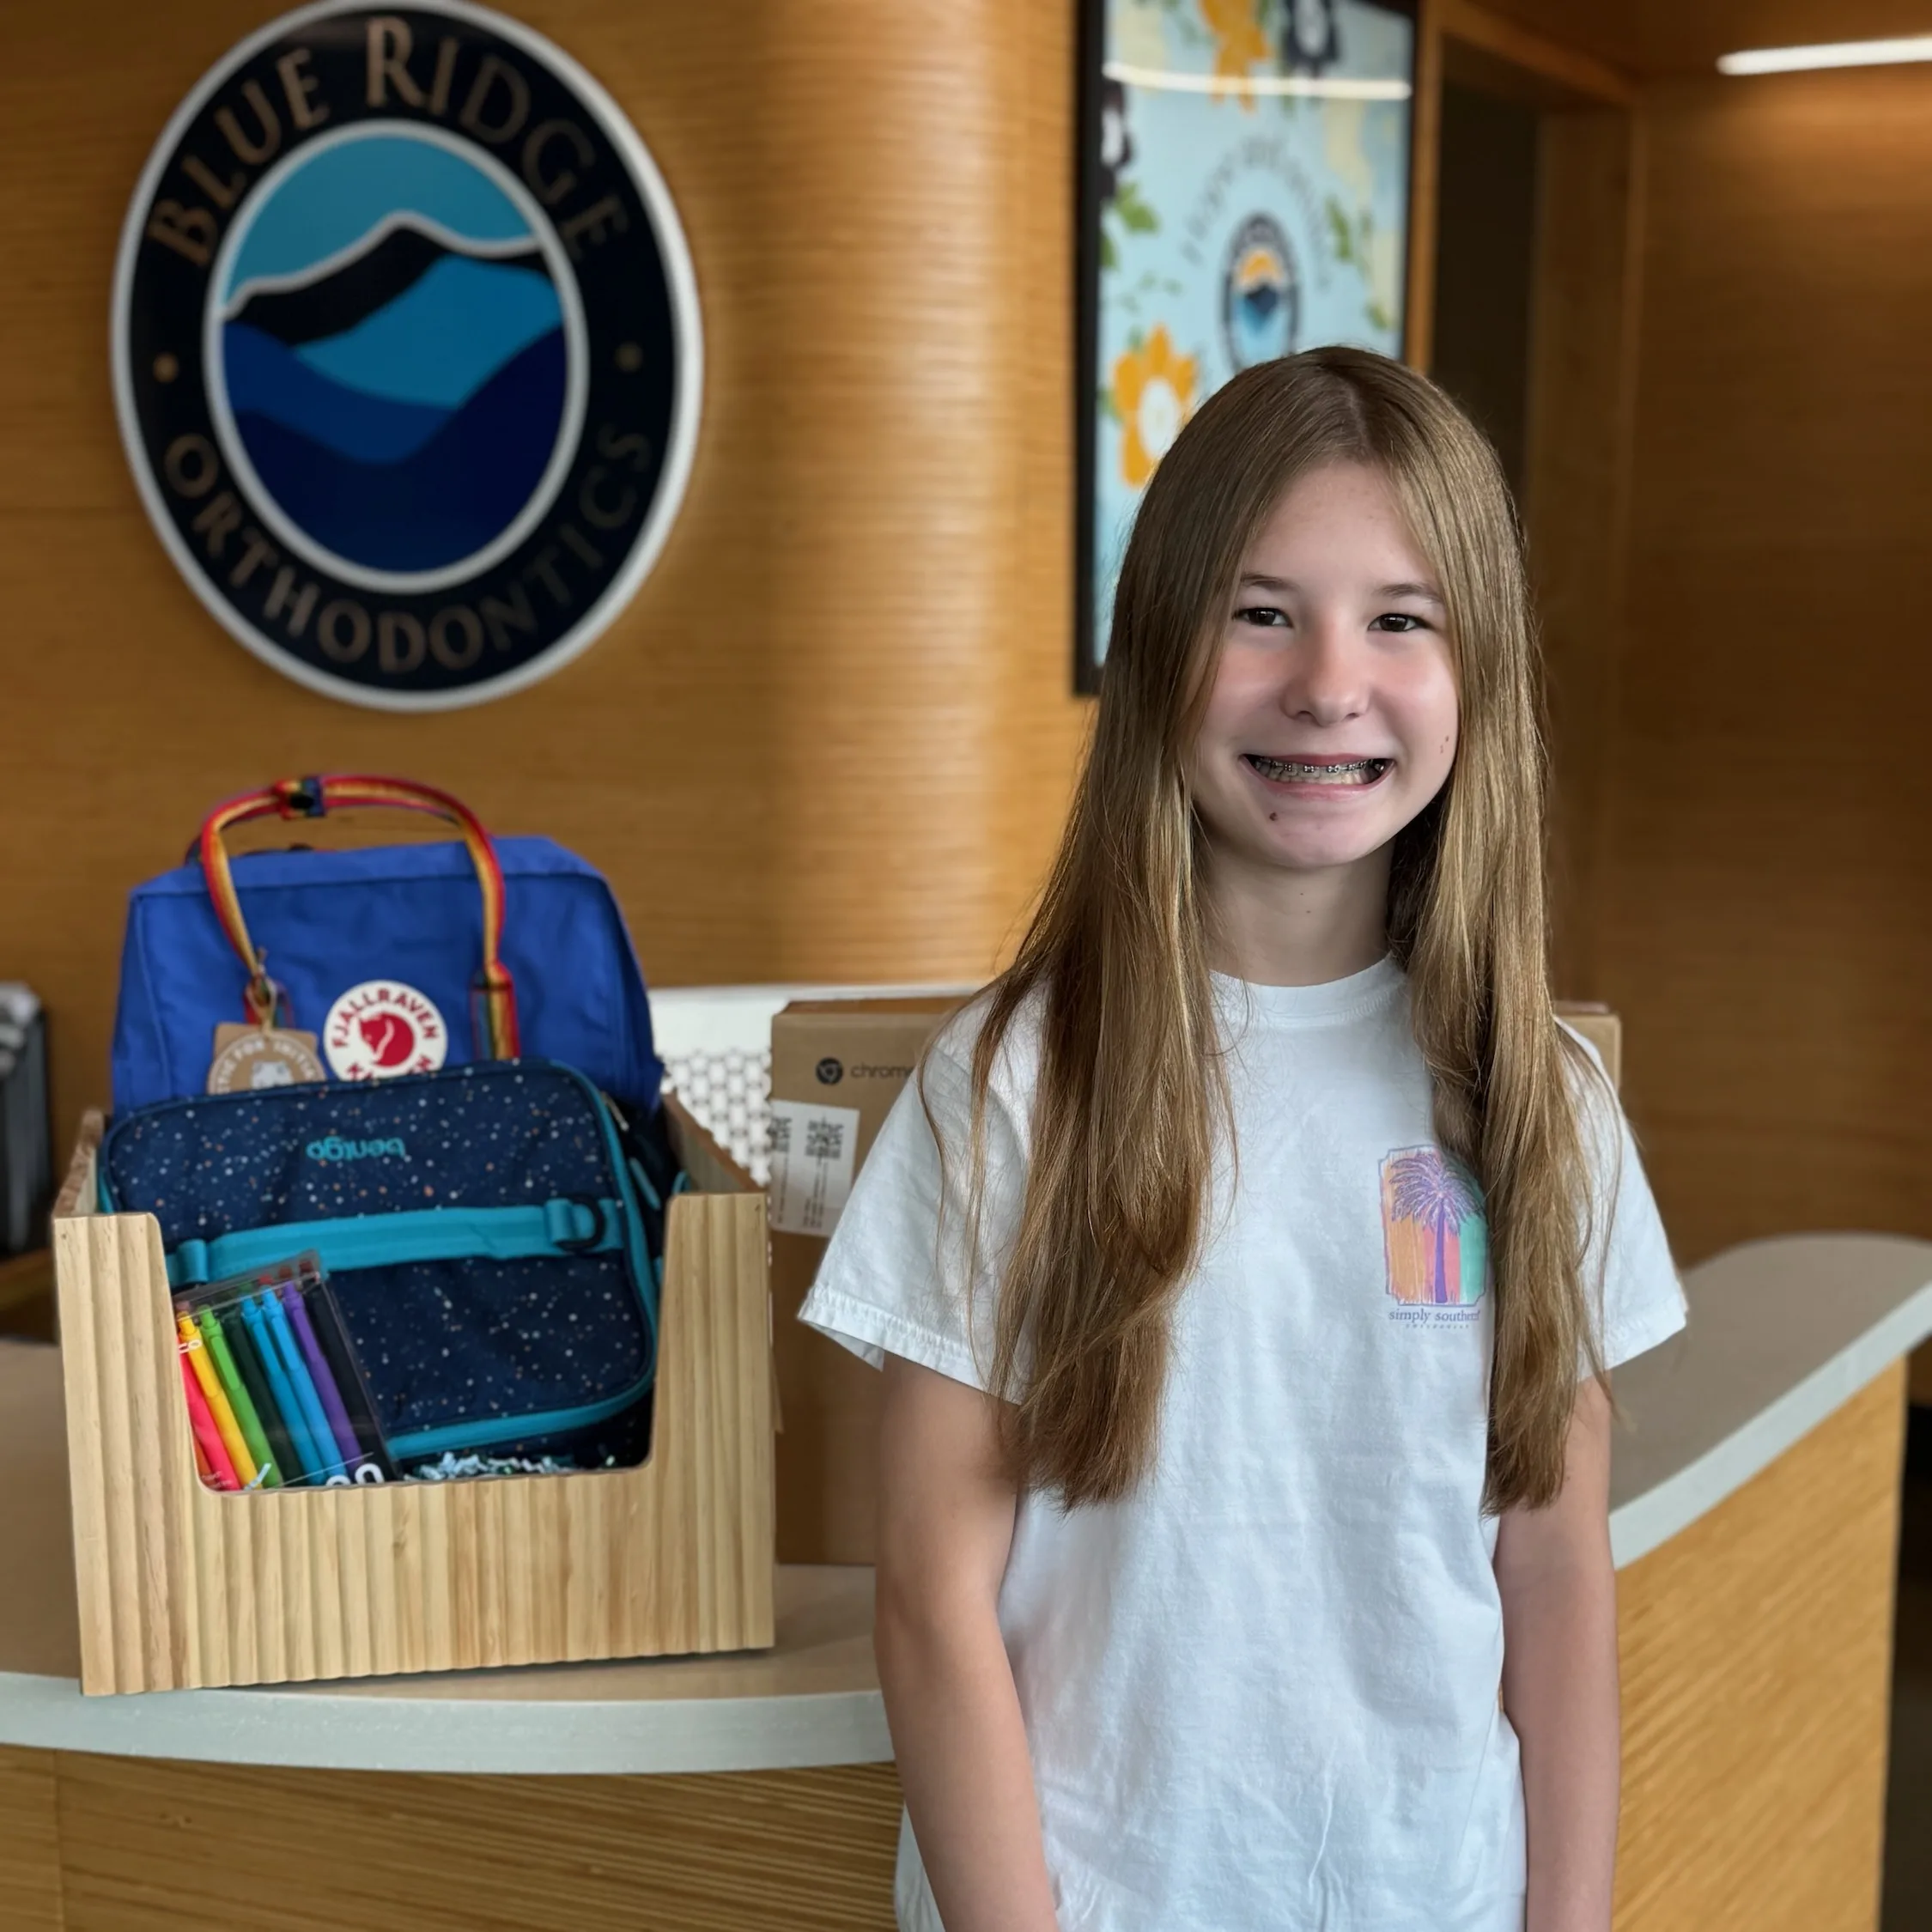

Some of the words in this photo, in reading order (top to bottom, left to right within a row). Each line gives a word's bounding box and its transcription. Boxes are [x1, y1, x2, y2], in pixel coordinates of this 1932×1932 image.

[146, 47, 329, 268] BLUE
[364, 15, 628, 260] RIDGE
[163, 422, 652, 674] ORTHODONTICS
[1388, 1308, 1431, 1323] simply
